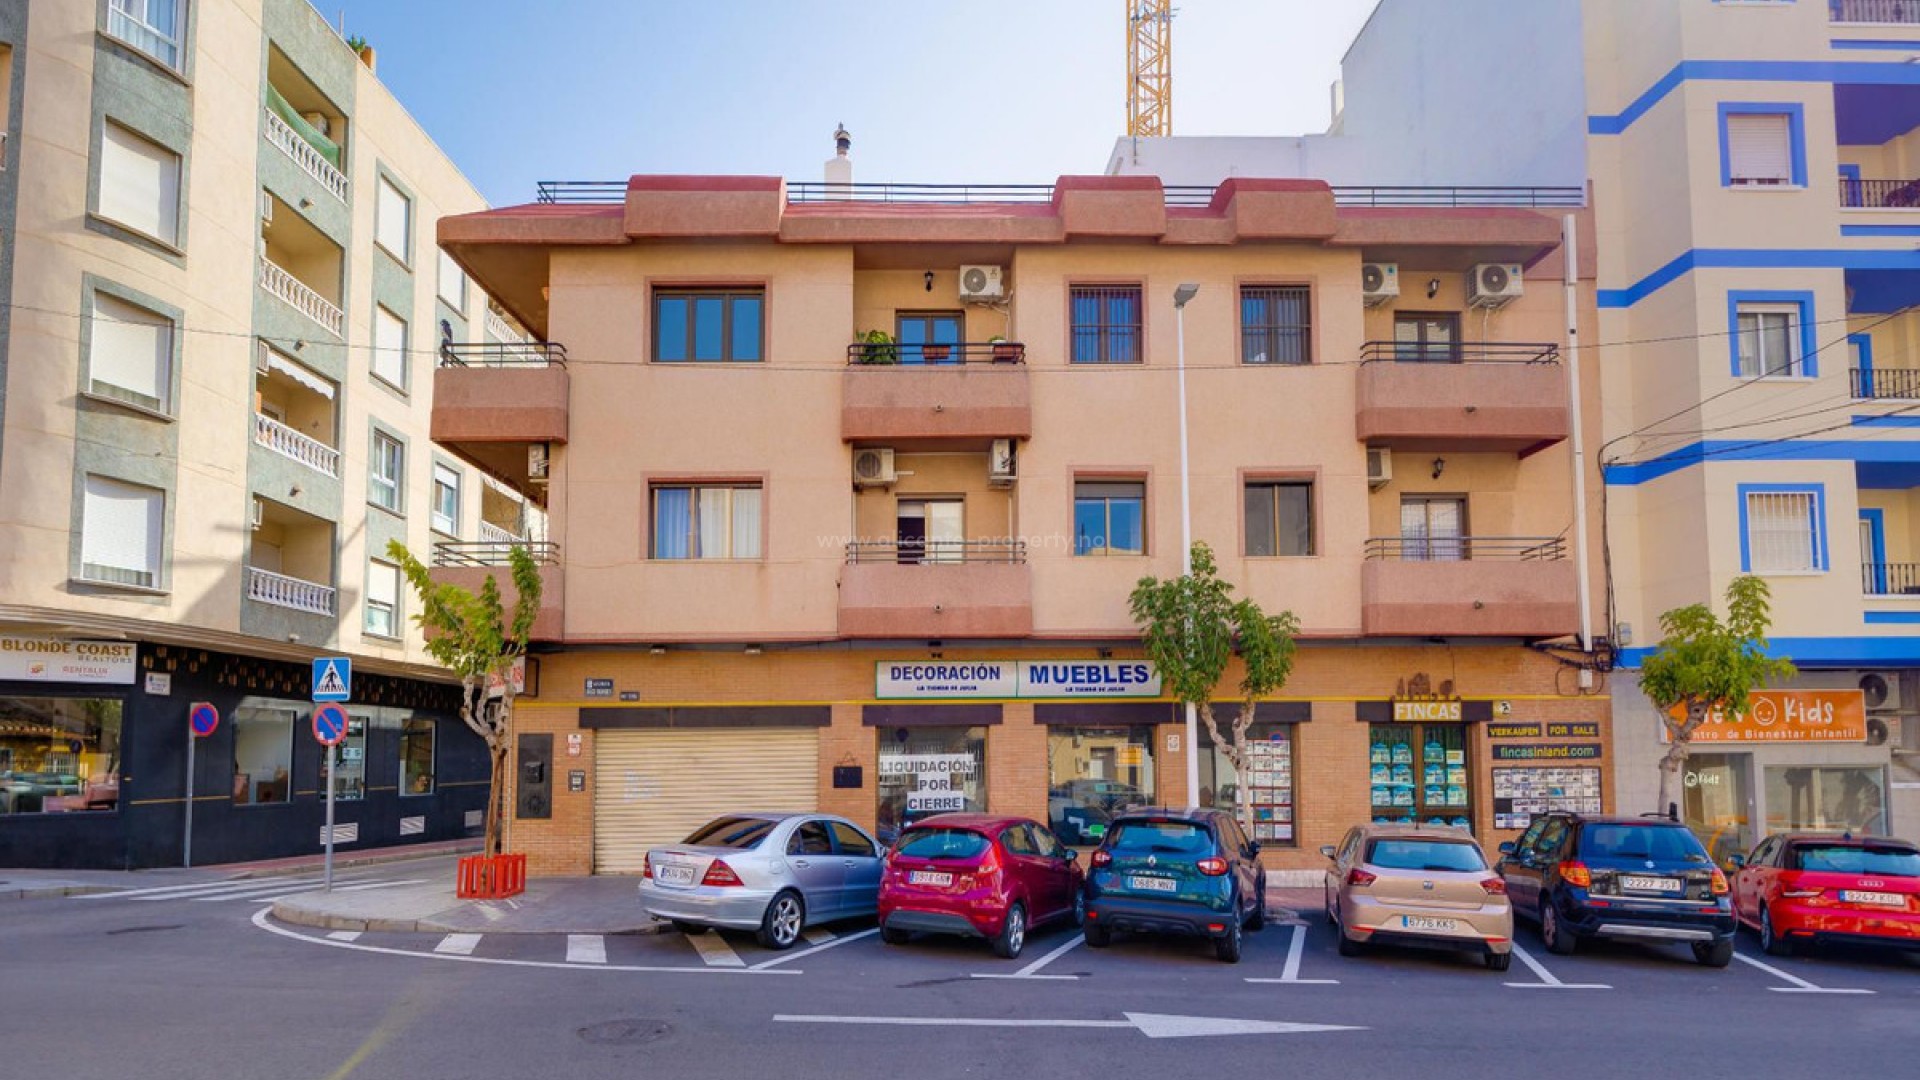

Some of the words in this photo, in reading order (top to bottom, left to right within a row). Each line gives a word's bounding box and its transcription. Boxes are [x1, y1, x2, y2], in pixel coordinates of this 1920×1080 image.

[2, 639, 71, 653] BLONDE
[76, 643, 132, 656] COAST
[77, 656, 132, 664] REALTORS
[890, 662, 1001, 680] DECORACIÓN
[1029, 664, 1150, 684] MUEBLES
[1394, 702, 1460, 720] FINCAS
[1784, 697, 1833, 724] Kids
[1489, 726, 1539, 736] VERKAUFEN
[1549, 726, 1568, 735] FOR
[1572, 726, 1595, 735] SALE
[1692, 730, 1718, 739] ntro
[1727, 730, 1739, 739] de
[1745, 729, 1805, 739] Bienestar
[1810, 729, 1857, 738] Infantil
[1500, 746, 1594, 758] fincasinland.com
[880, 759, 973, 772] LIQUIDACIÓN
[919, 779, 948, 790] POR
[908, 798, 961, 809] CIERRE
